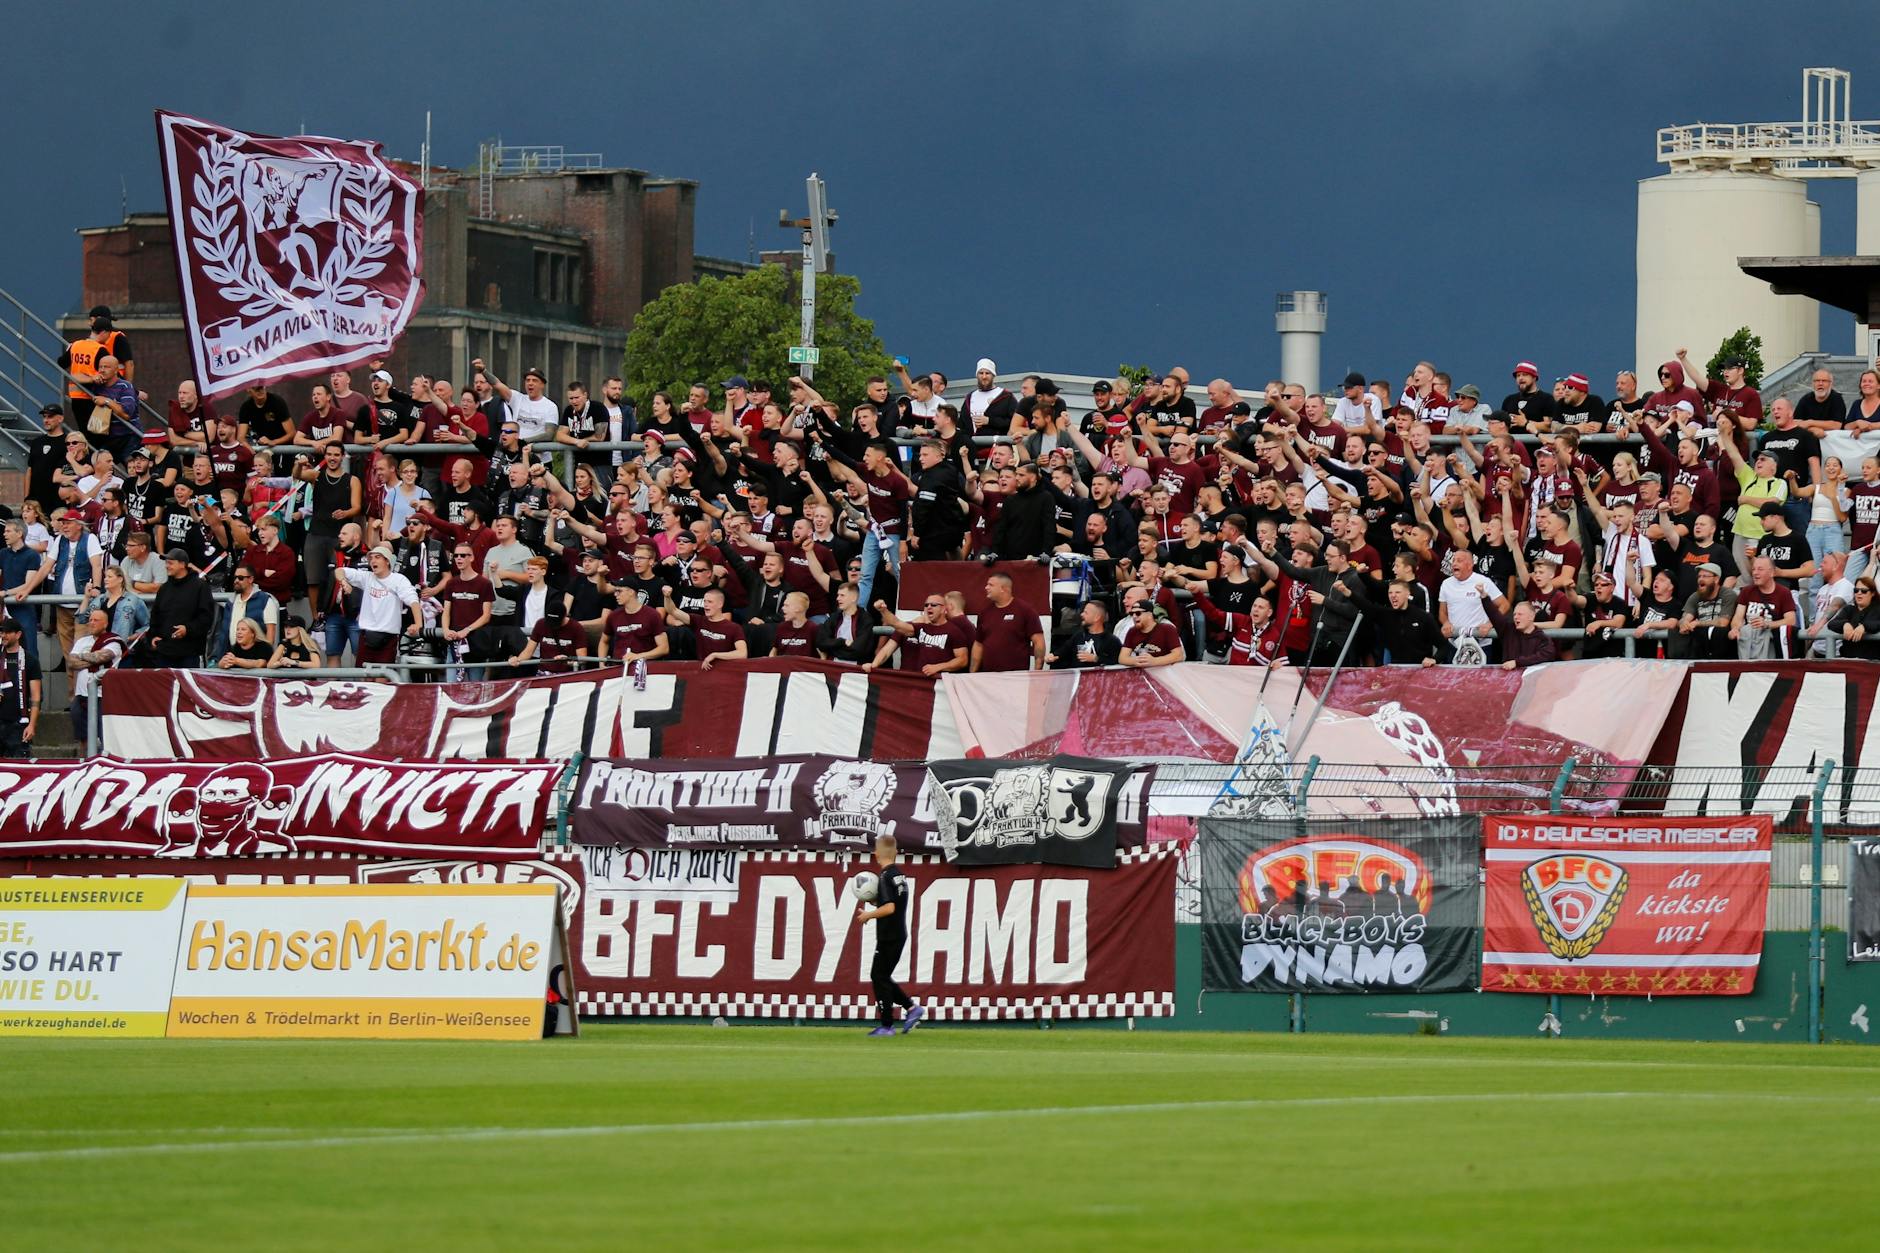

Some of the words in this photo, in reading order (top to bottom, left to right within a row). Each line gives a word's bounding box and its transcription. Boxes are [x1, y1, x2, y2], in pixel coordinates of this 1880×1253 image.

[227, 310, 311, 365] DYNAMO
[72, 353, 91, 365] 053
[1856, 494, 1880, 510] BFC
[168, 513, 194, 531] BFC
[1663, 672, 1880, 824] KA
[284, 760, 542, 836] INVICTA
[667, 823, 719, 843] BERLINER
[720, 822, 778, 843] FUSSBALL
[1498, 825, 1518, 841] 10
[1533, 826, 1662, 843] DEUTSCHER
[1665, 827, 1758, 844] MEISTER
[1261, 851, 1406, 899] BFC
[1534, 857, 1613, 890] BFC
[1667, 868, 1702, 890] da
[0, 891, 144, 903] USTELLENSERVICE
[1636, 894, 1730, 915] kiekste
[580, 898, 730, 978] BFC
[1242, 913, 1427, 944] BLACKBOYS
[1655, 921, 1710, 944] wa!
[187, 918, 540, 972] HansaMarkt.de
[1853, 941, 1880, 957] Lei
[2, 951, 39, 972] SO
[48, 951, 122, 972] HART
[1240, 943, 1428, 985] DYNAMO
[55, 979, 99, 1000] DU.
[178, 1012, 239, 1025] Wochen
[245, 1012, 256, 1025] &
[265, 1010, 360, 1026] Trödelmarkt
[368, 1012, 382, 1025] in
[389, 1012, 531, 1027] Berlin-Weißensee
